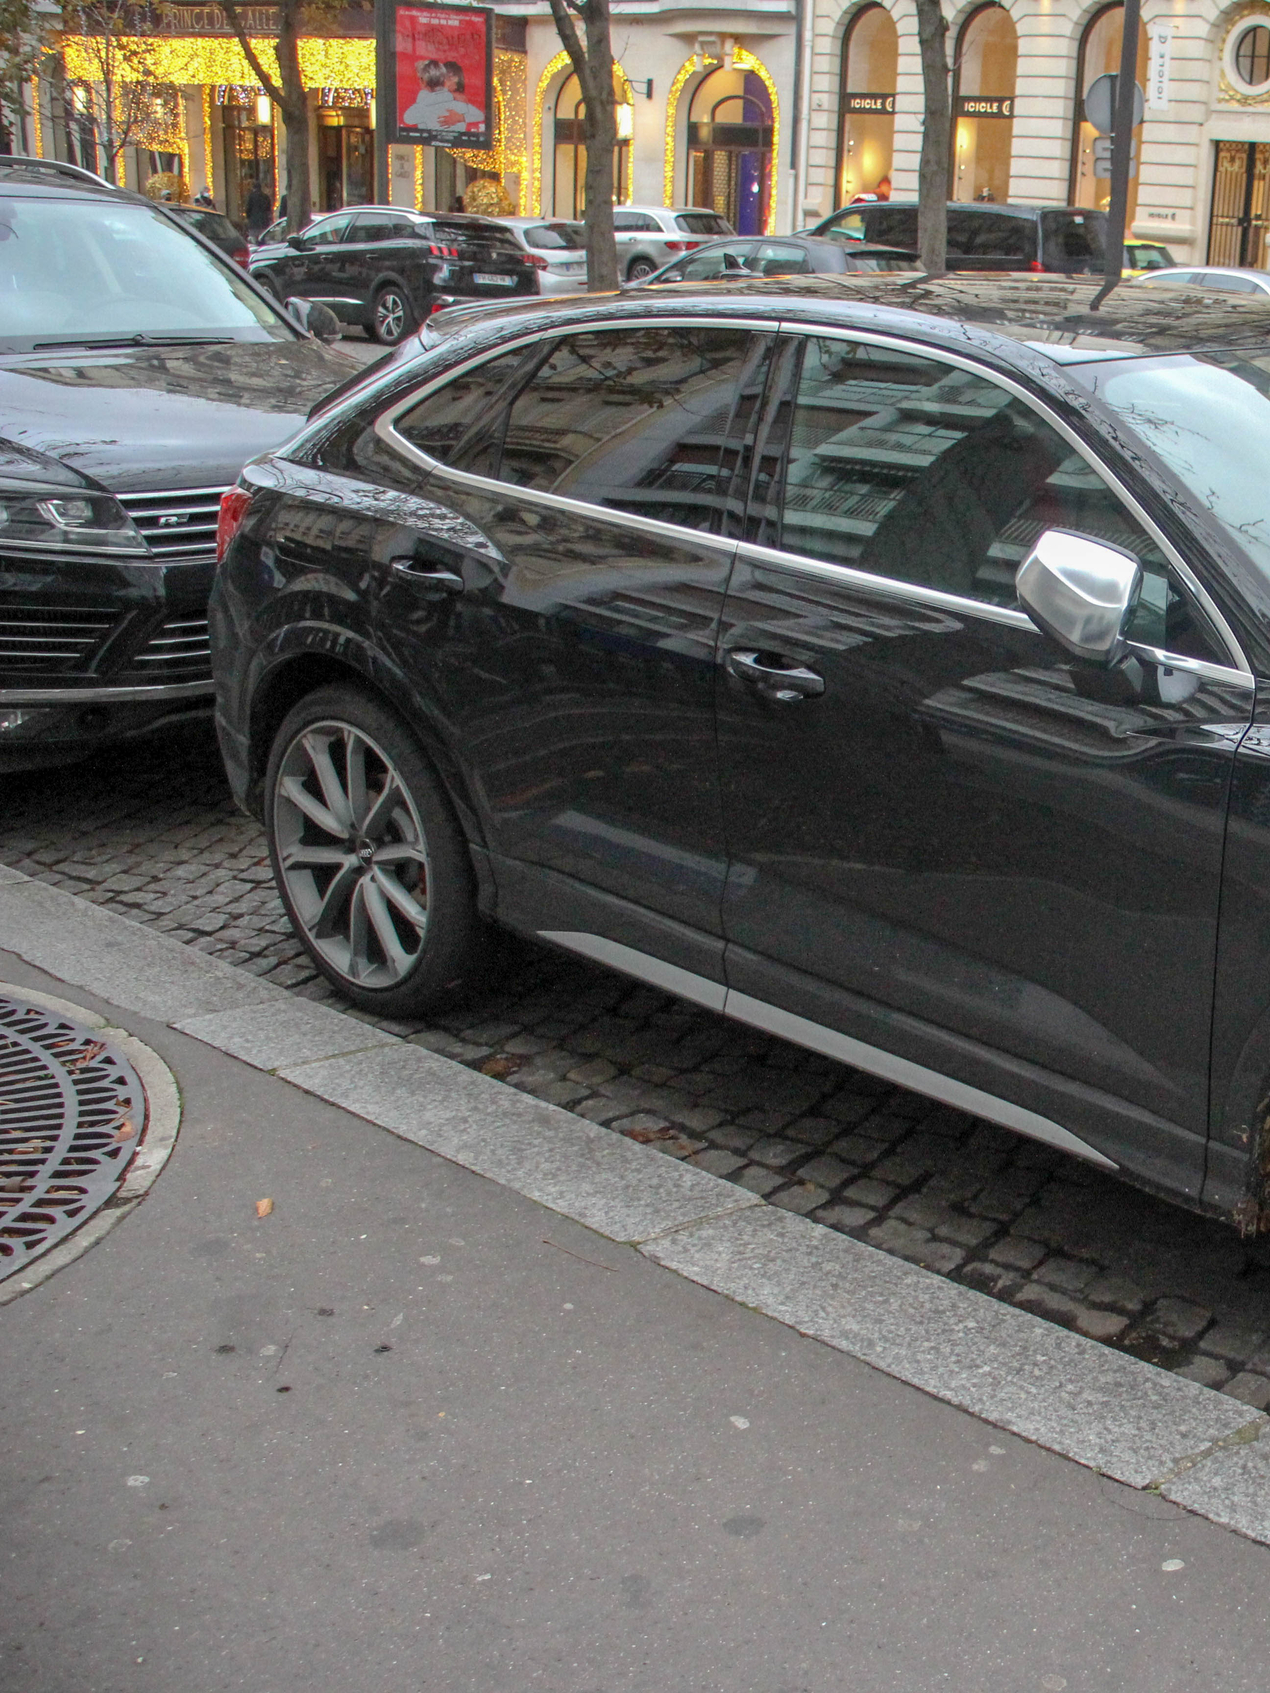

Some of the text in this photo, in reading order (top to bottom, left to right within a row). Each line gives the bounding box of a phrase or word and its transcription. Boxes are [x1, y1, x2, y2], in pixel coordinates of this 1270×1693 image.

[162, 9, 211, 29] PRINCE
[235, 9, 281, 30] ALLE
[1157, 52, 1166, 99] ICICLE
[851, 98, 882, 109] ICICLE
[964, 101, 999, 113] ICICLE
